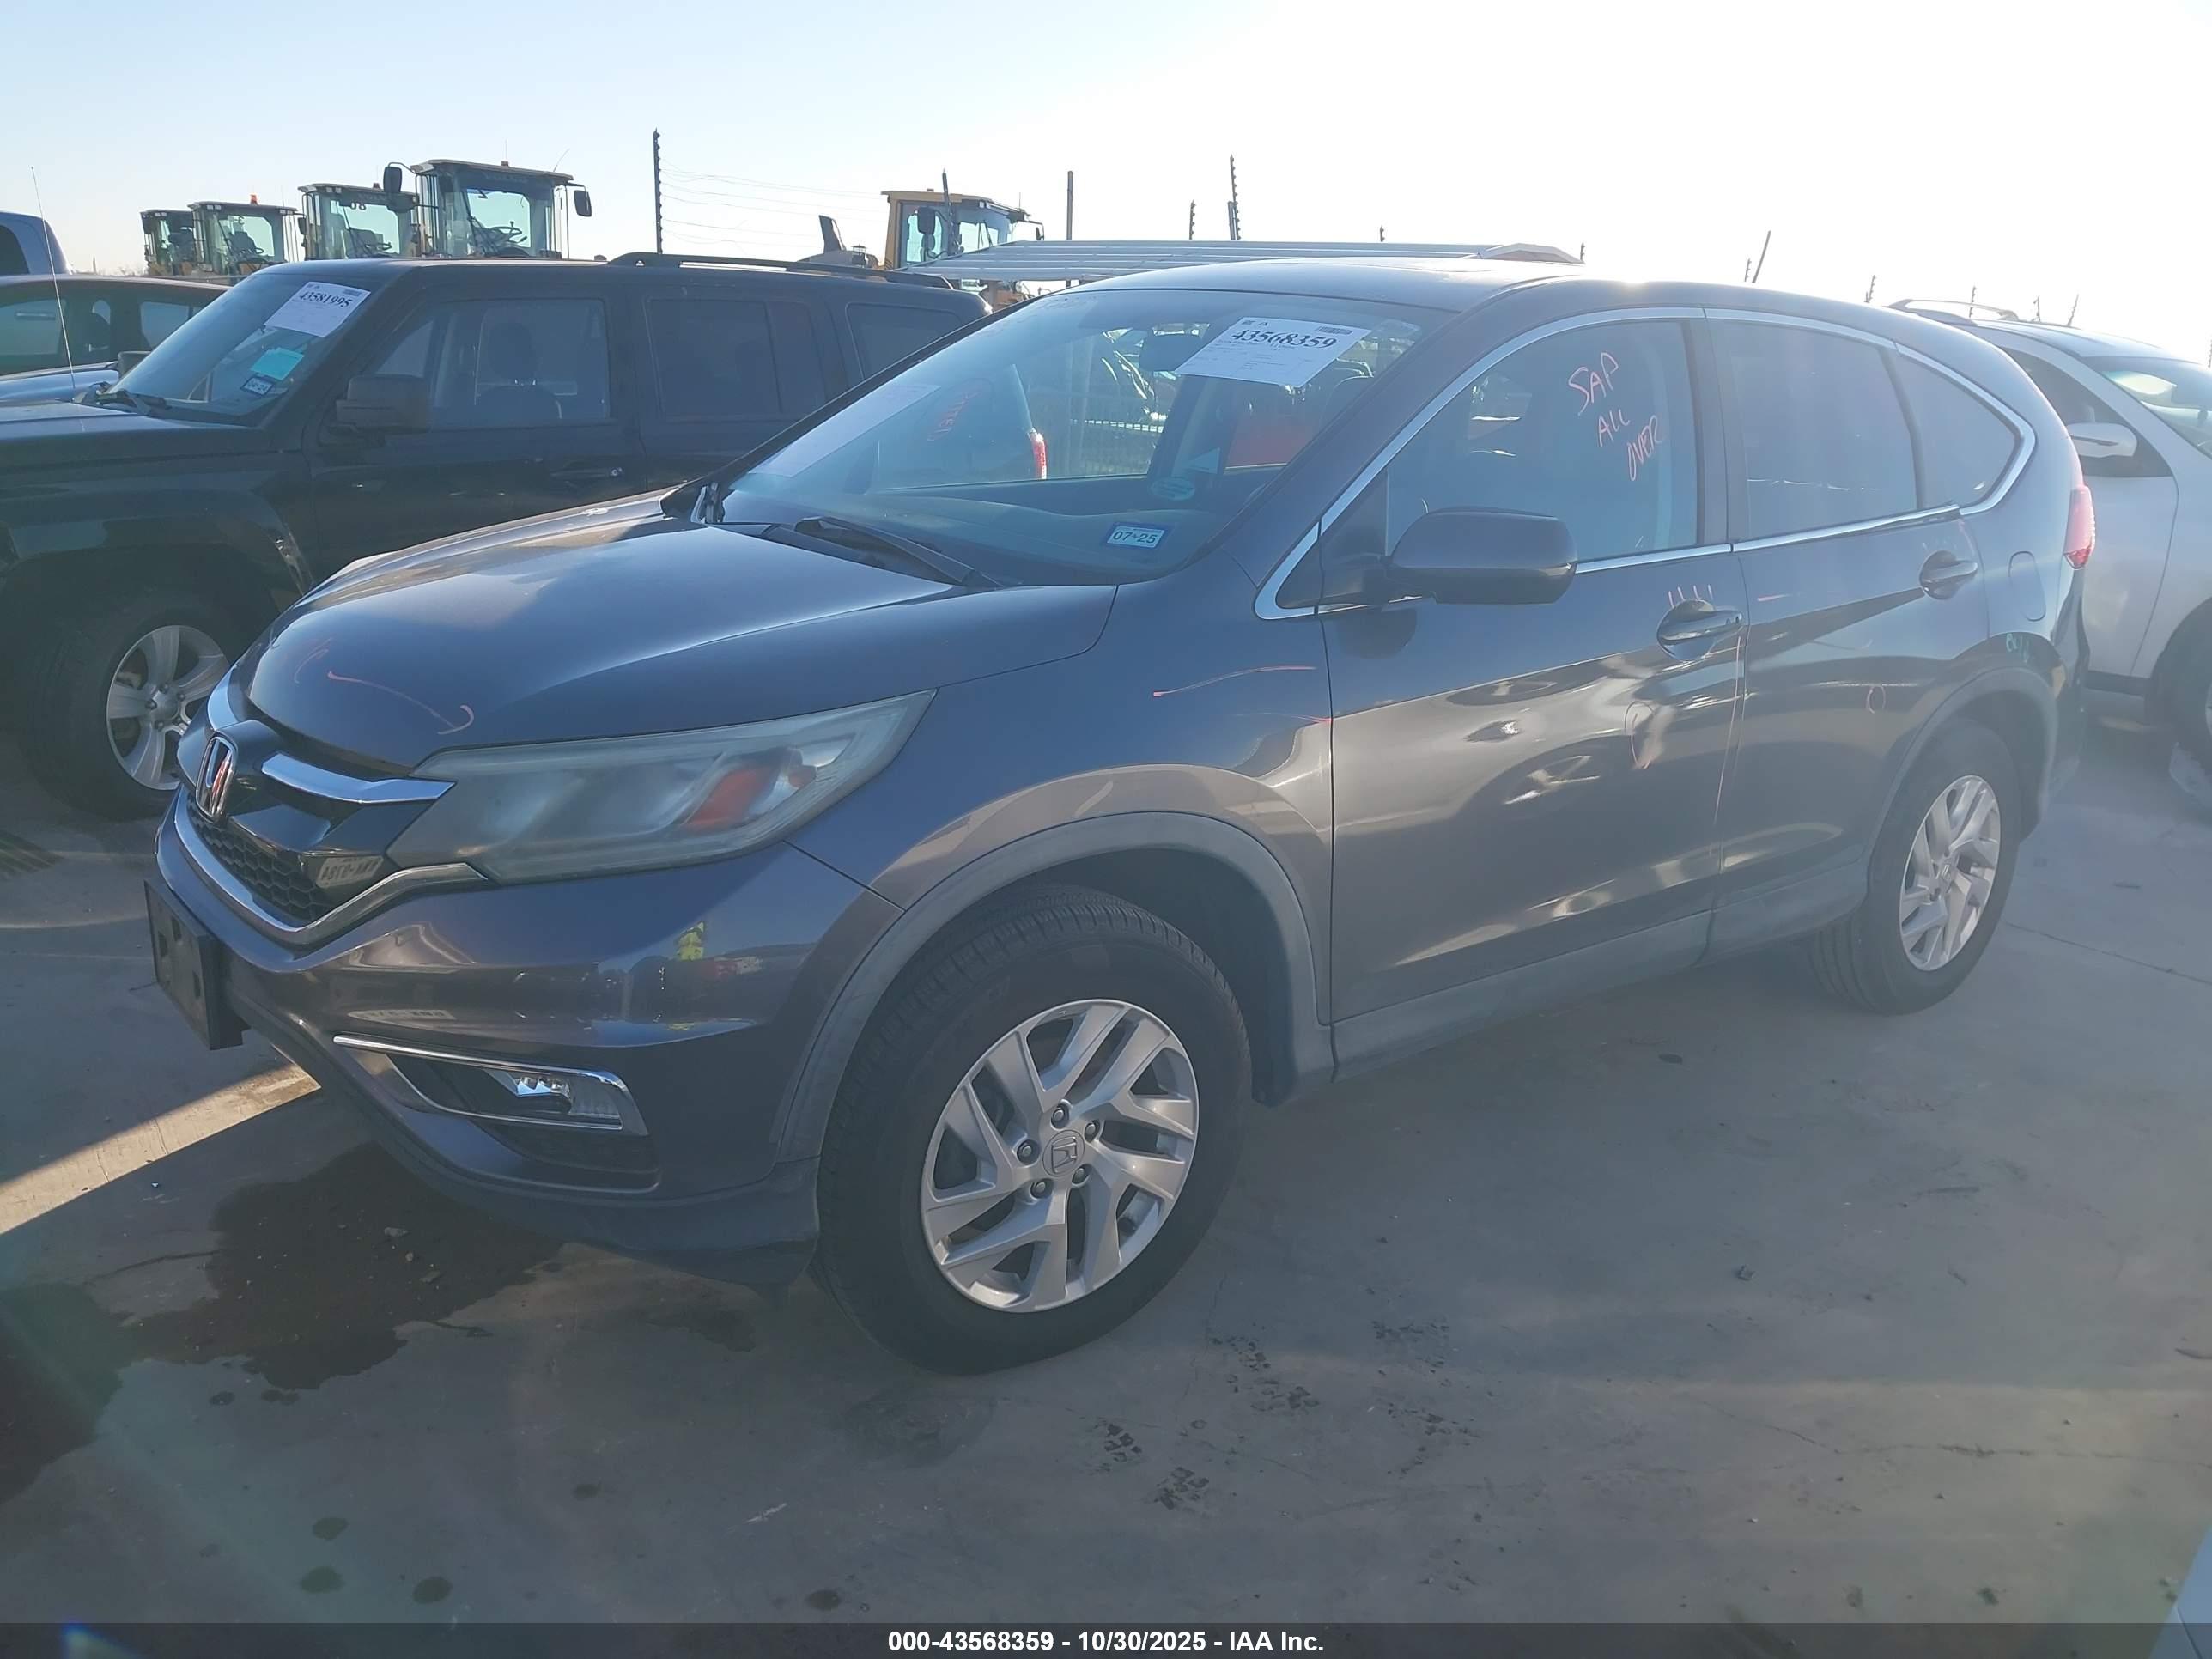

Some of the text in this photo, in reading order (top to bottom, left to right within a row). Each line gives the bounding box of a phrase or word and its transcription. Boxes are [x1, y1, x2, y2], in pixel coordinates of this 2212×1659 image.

[299, 292, 353, 307] 43581995
[1231, 329, 1338, 349] 43568359
[1568, 352, 1619, 416] SAP
[1598, 408, 1631, 447] ALL
